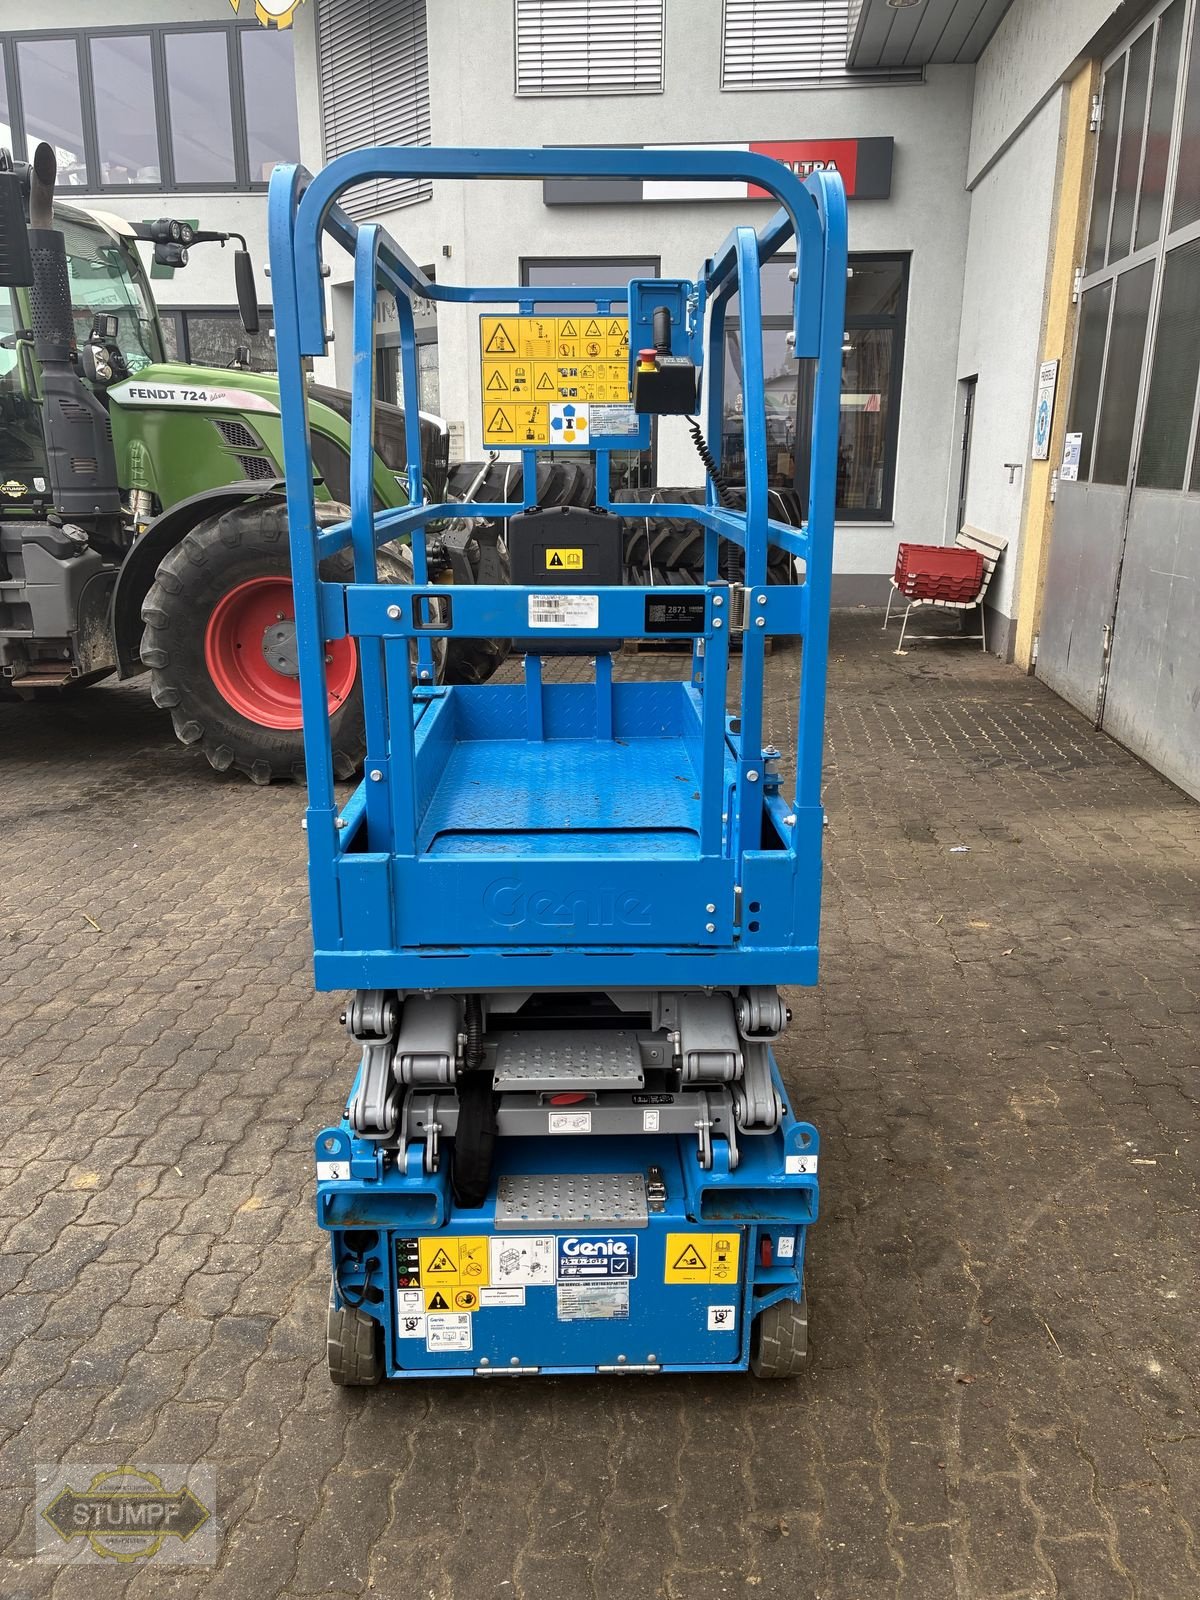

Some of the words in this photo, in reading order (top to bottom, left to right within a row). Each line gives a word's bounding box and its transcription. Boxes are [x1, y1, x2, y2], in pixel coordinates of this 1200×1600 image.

[776, 159, 838, 178] ALTRA
[128, 388, 176, 400] FENDT
[180, 391, 208, 402] 724
[667, 606, 687, 614] 2871
[482, 876, 652, 926] Genie
[563, 1238, 629, 1256] Genie
